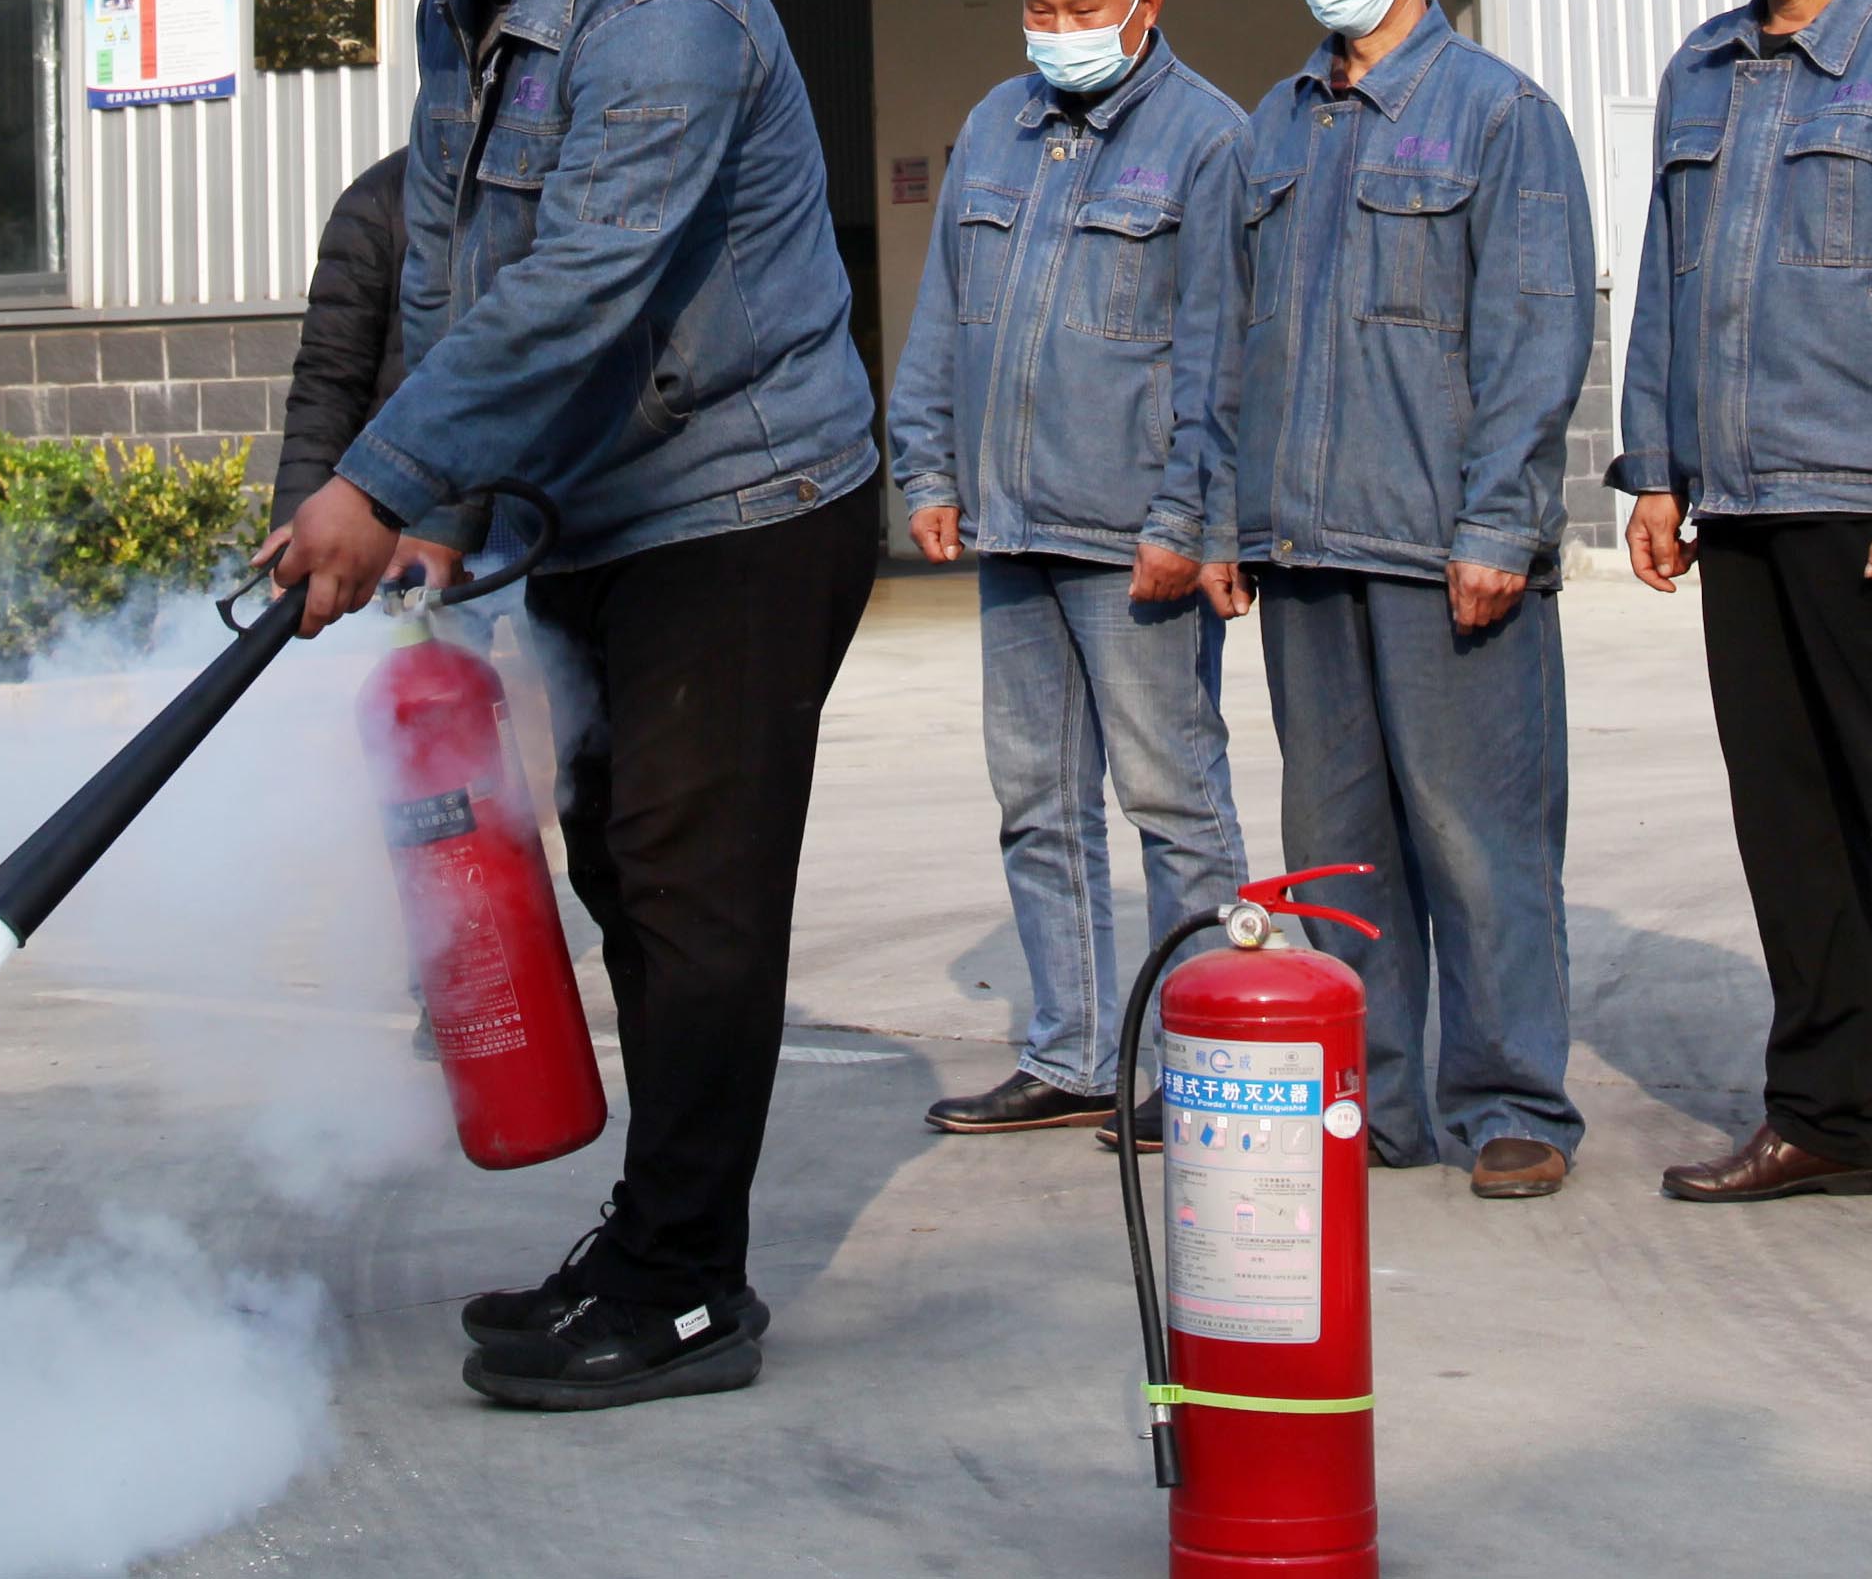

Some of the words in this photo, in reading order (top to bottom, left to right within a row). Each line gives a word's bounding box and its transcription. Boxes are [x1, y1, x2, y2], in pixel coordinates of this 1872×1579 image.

[1164, 1072, 1309, 1105] 手提式干粉灭火器
[1197, 1098, 1227, 1109] Powder
[1231, 1102, 1249, 1111] Fire
[1252, 1103, 1308, 1113] Extinguisher
